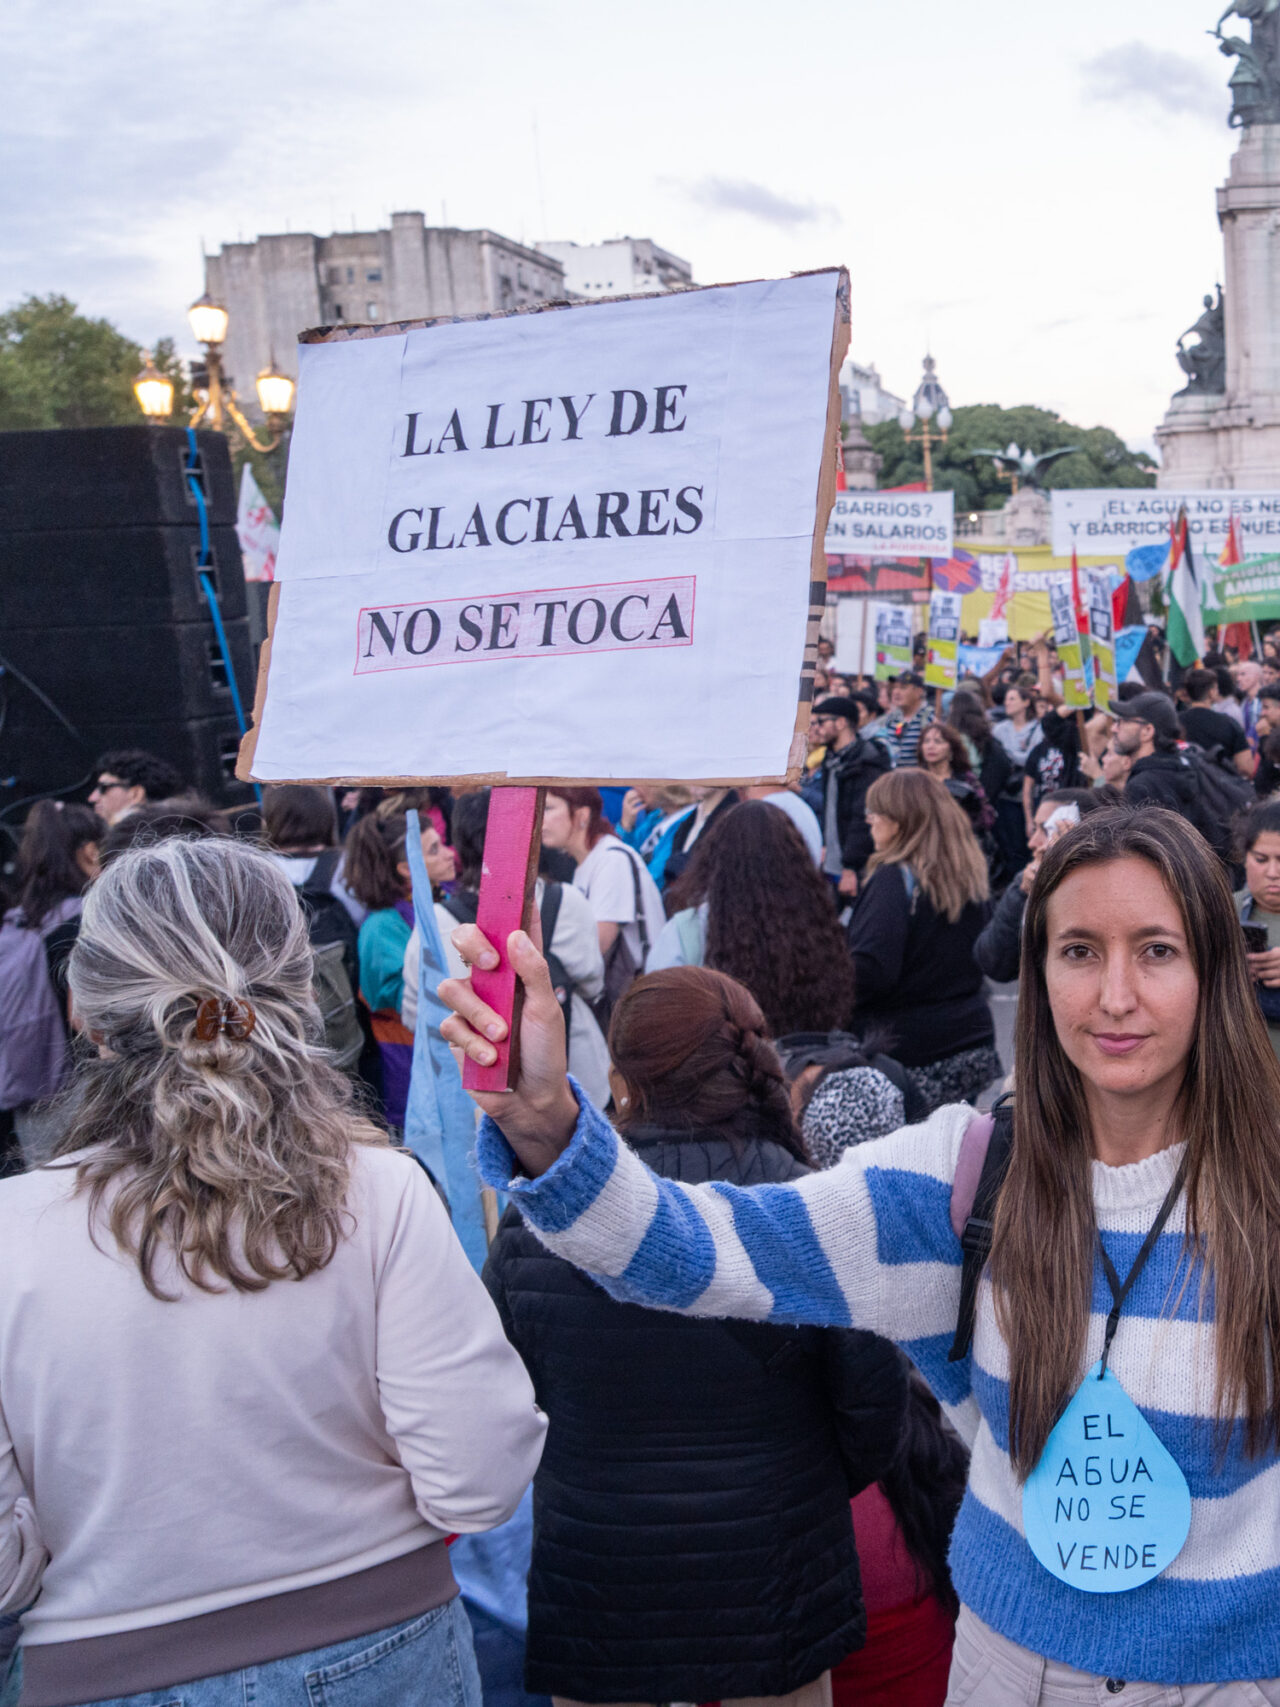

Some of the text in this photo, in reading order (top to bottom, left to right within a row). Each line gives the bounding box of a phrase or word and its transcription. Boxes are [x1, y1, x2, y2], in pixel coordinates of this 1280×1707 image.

[400, 384, 688, 458] LA LEY DE
[387, 485, 704, 553] GLACIARES
[836, 500, 933, 518] BARRIOS?
[1136, 499, 1191, 515] AGUA
[1196, 499, 1224, 514] NO
[1231, 499, 1253, 514] ES
[852, 522, 948, 541] SALARIOS
[1069, 522, 1082, 536] Y
[1087, 520, 1171, 536] BARRICK
[1209, 519, 1232, 534] ES
[362, 592, 690, 658] NO SE TOCA
[1083, 1413, 1125, 1440] EL
[1055, 1456, 1153, 1486] AGUA
[1054, 1495, 1147, 1523] NO SE
[1056, 1541, 1157, 1571] VENDE
